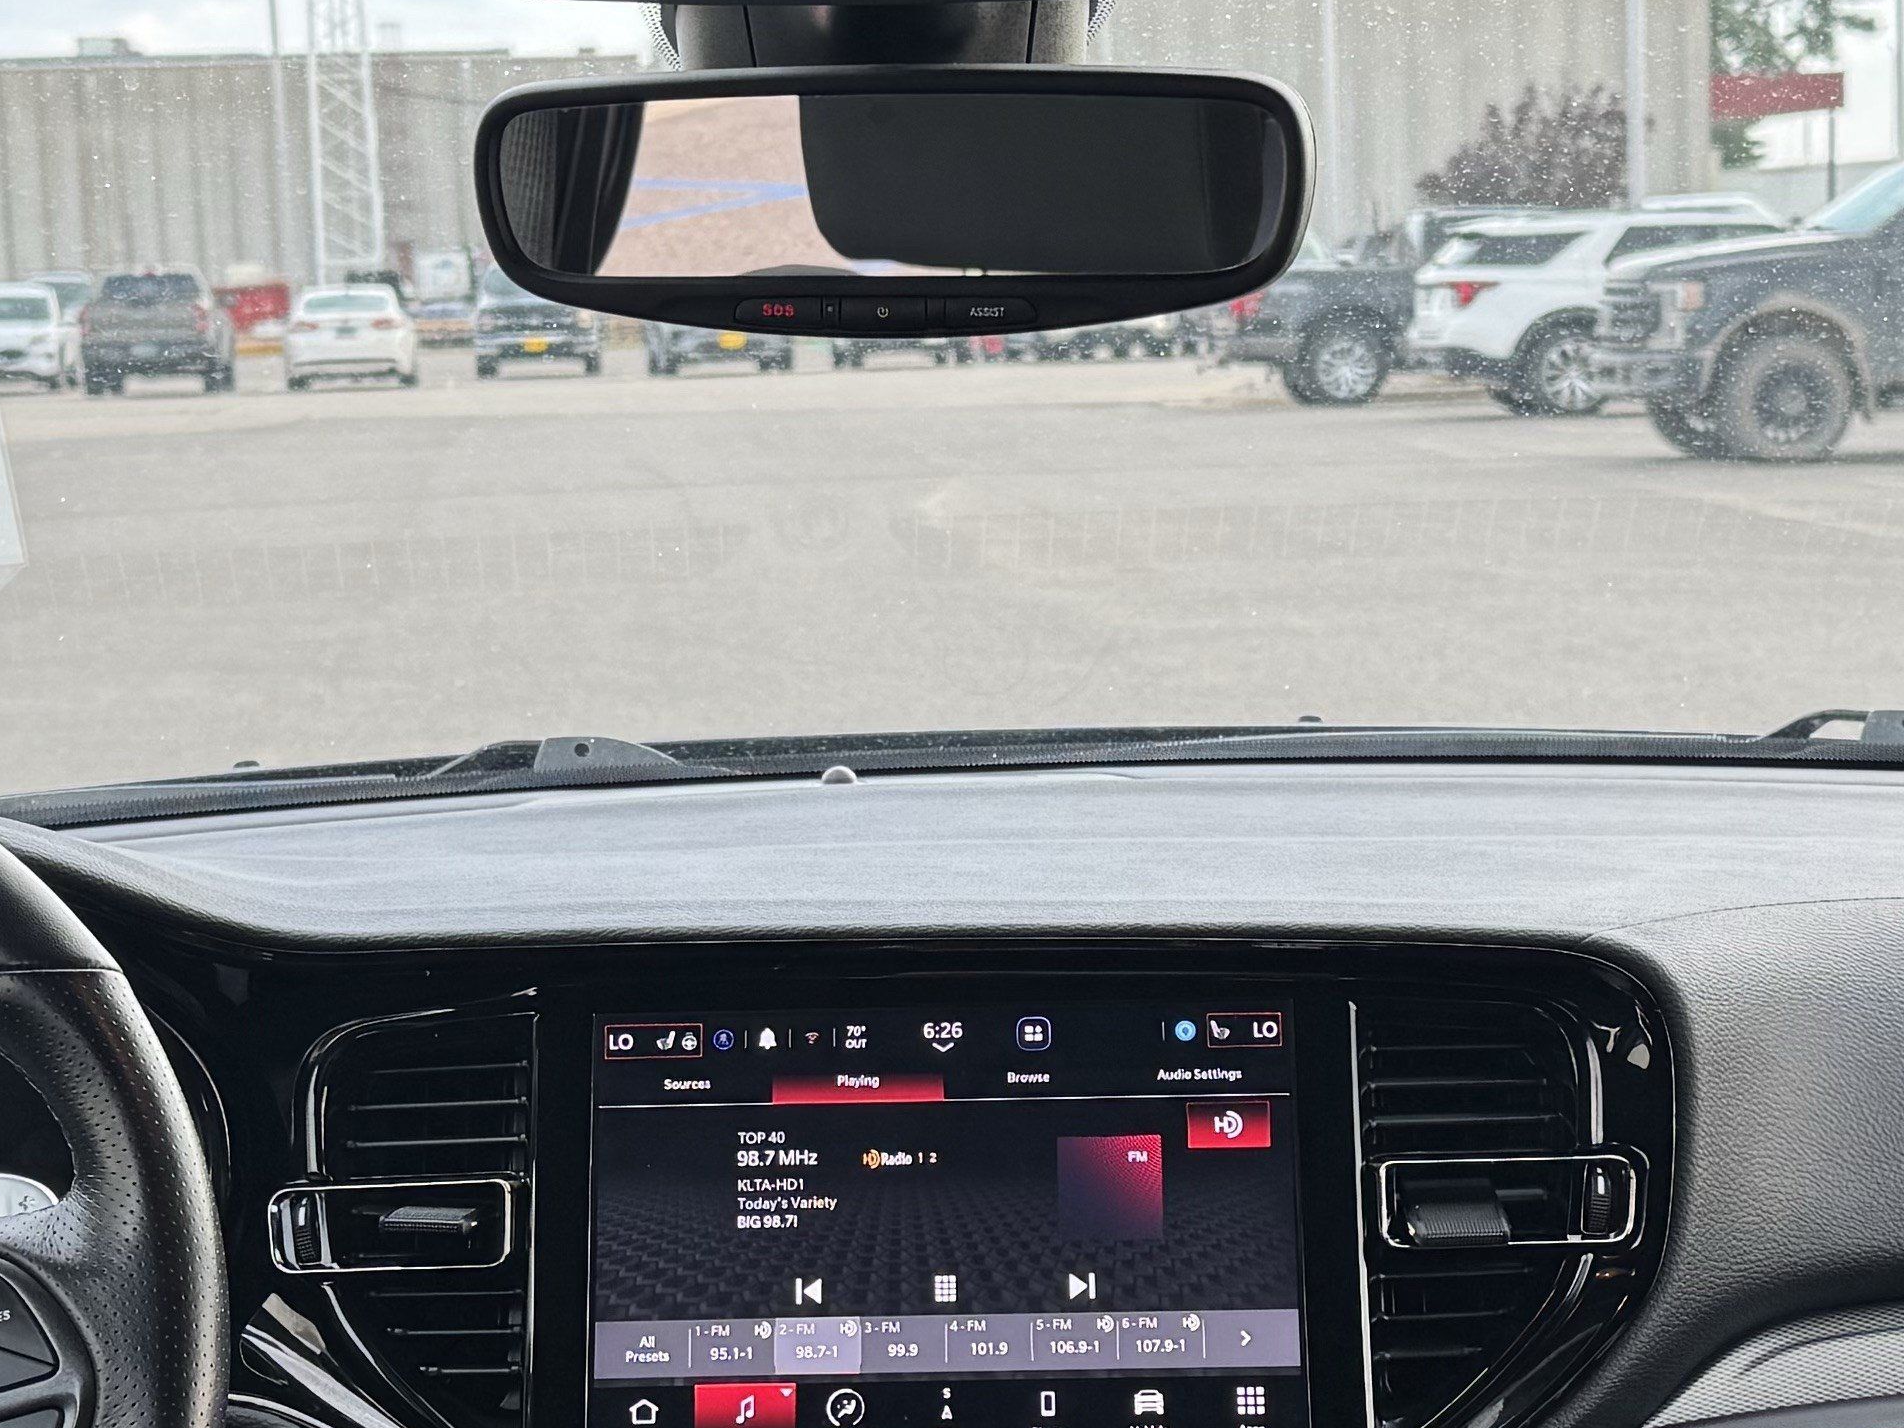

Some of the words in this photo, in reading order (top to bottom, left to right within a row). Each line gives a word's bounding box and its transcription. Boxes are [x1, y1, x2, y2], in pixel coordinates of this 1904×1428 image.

[762, 303, 795, 318] SOS
[970, 306, 1005, 317] ASSIST
[846, 1026, 866, 1037] 70°
[922, 1021, 964, 1039] 6:26
[1252, 1021, 1279, 1038] LO
[608, 1033, 634, 1051] LO
[845, 1037, 867, 1049] OUT
[836, 1073, 880, 1089] Playing
[1006, 1071, 1051, 1084] Browse
[1157, 1068, 1192, 1081] Audio
[1193, 1068, 1243, 1081] Settings
[663, 1077, 711, 1091] Sources
[737, 1131, 766, 1144] TOP
[767, 1130, 786, 1144] 40
[737, 1149, 776, 1167] 98.7
[778, 1149, 818, 1166] MHz
[881, 1151, 913, 1166] Radio
[1127, 1150, 1149, 1164] FM
[737, 1178, 804, 1192] KLTA-HD1
[737, 1196, 788, 1211] Today's
[790, 1195, 838, 1211] Variety
[737, 1215, 761, 1229] BIG
[638, 1335, 656, 1349] All
[970, 1342, 1008, 1355] 101.9
[1049, 1339, 1101, 1354] 106.9-1
[1135, 1338, 1187, 1353] 107.9-1
[625, 1349, 671, 1364] Presets
[709, 1346, 754, 1361] 95.1-1
[796, 1345, 838, 1359] 98.7-1
[887, 1343, 919, 1358] 99.9
